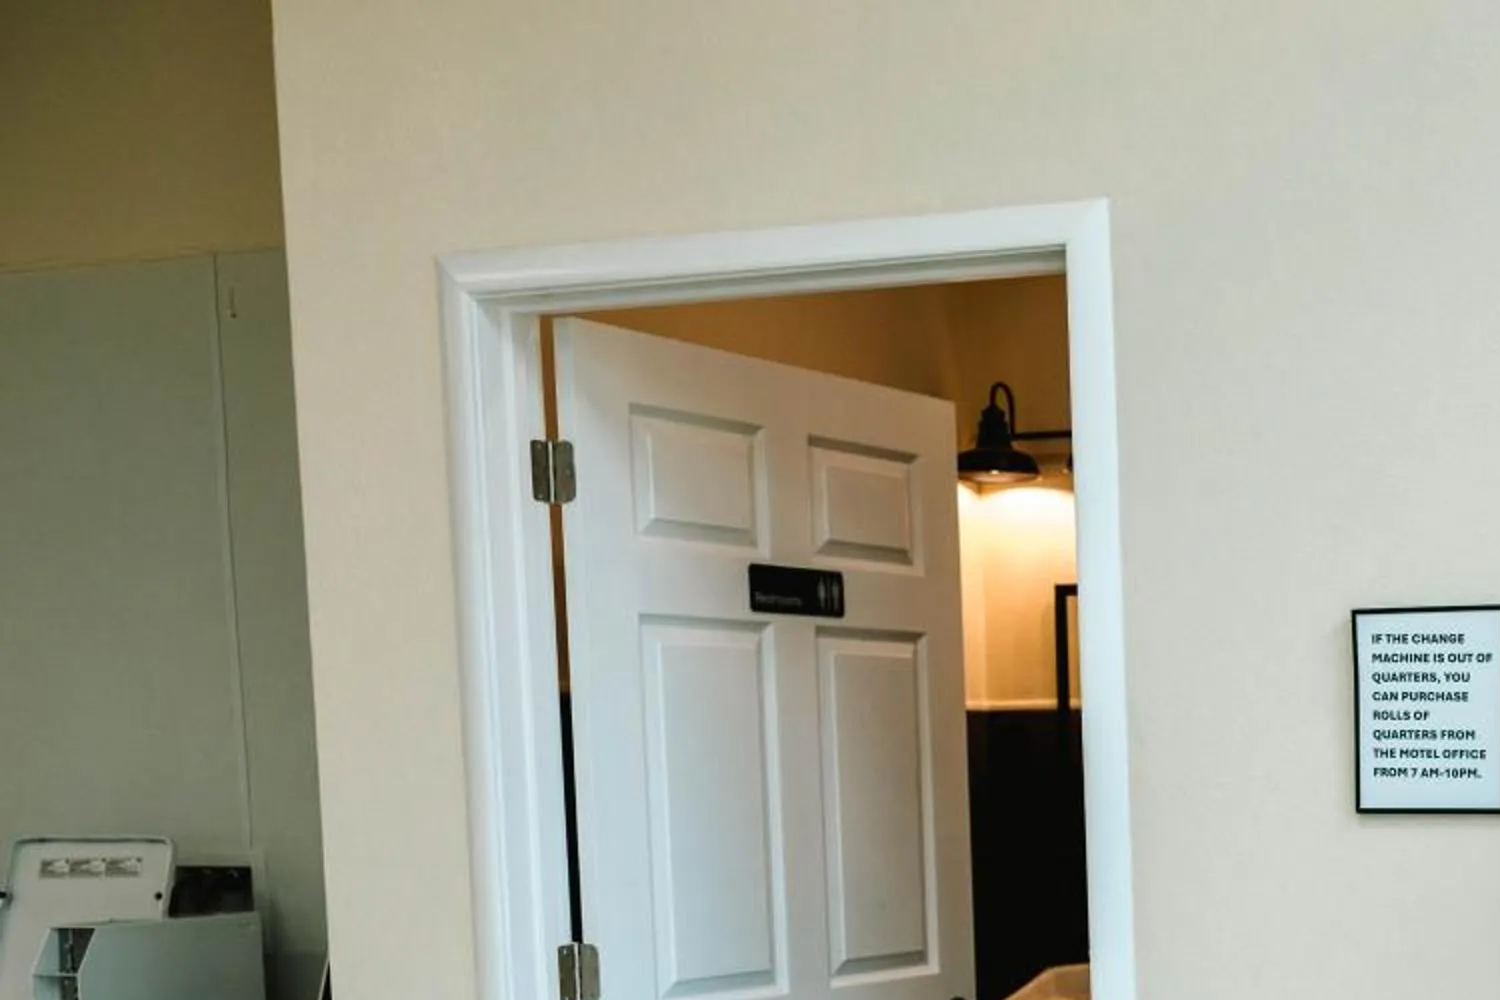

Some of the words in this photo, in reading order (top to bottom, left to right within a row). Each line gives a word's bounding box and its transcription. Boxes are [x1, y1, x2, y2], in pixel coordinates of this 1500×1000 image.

[1371, 633, 1383, 645] IF
[1386, 633, 1408, 645] THE
[1411, 633, 1465, 645] CHANGE
[1371, 653, 1430, 664] MACHINE
[1433, 653, 1445, 663] IS
[1447, 653, 1473, 663] OUT
[1475, 653, 1493, 663] OF
[1371, 672, 1441, 684] QUARTERS,
[1443, 672, 1471, 683] YOU
[1371, 691, 1399, 702] CAN
[1401, 691, 1469, 702] PURCHASE
[1373, 710, 1411, 721] ROLLS
[1413, 710, 1430, 721] OF
[1373, 729, 1438, 741] QUARTERS
[1440, 729, 1476, 740] FROM
[1373, 748, 1397, 759] THE
[1399, 749, 1440, 759] MOTEL
[1442, 749, 1487, 759] OFFICE
[1373, 768, 1408, 778] FROM
[1411, 768, 1418, 778] 7
